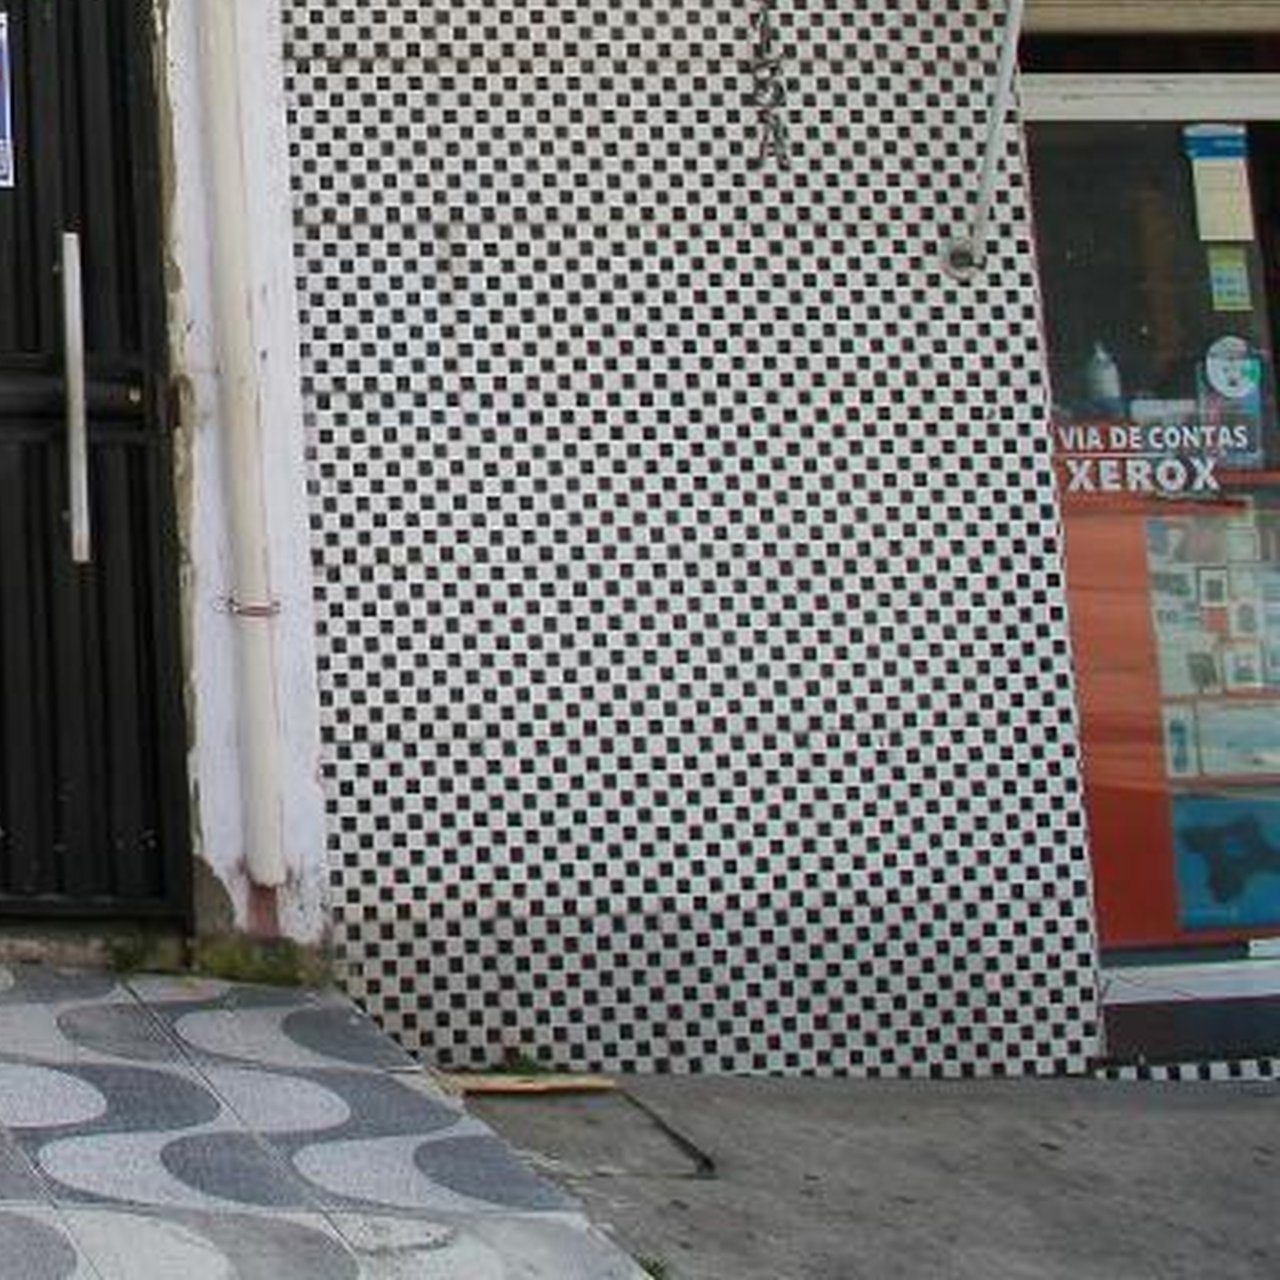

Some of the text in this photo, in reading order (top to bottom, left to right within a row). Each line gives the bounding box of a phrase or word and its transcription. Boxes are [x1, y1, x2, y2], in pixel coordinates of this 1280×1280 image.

[1057, 425, 1248, 450] VIA DE CONTAS
[1065, 457, 1221, 492] XEROX
